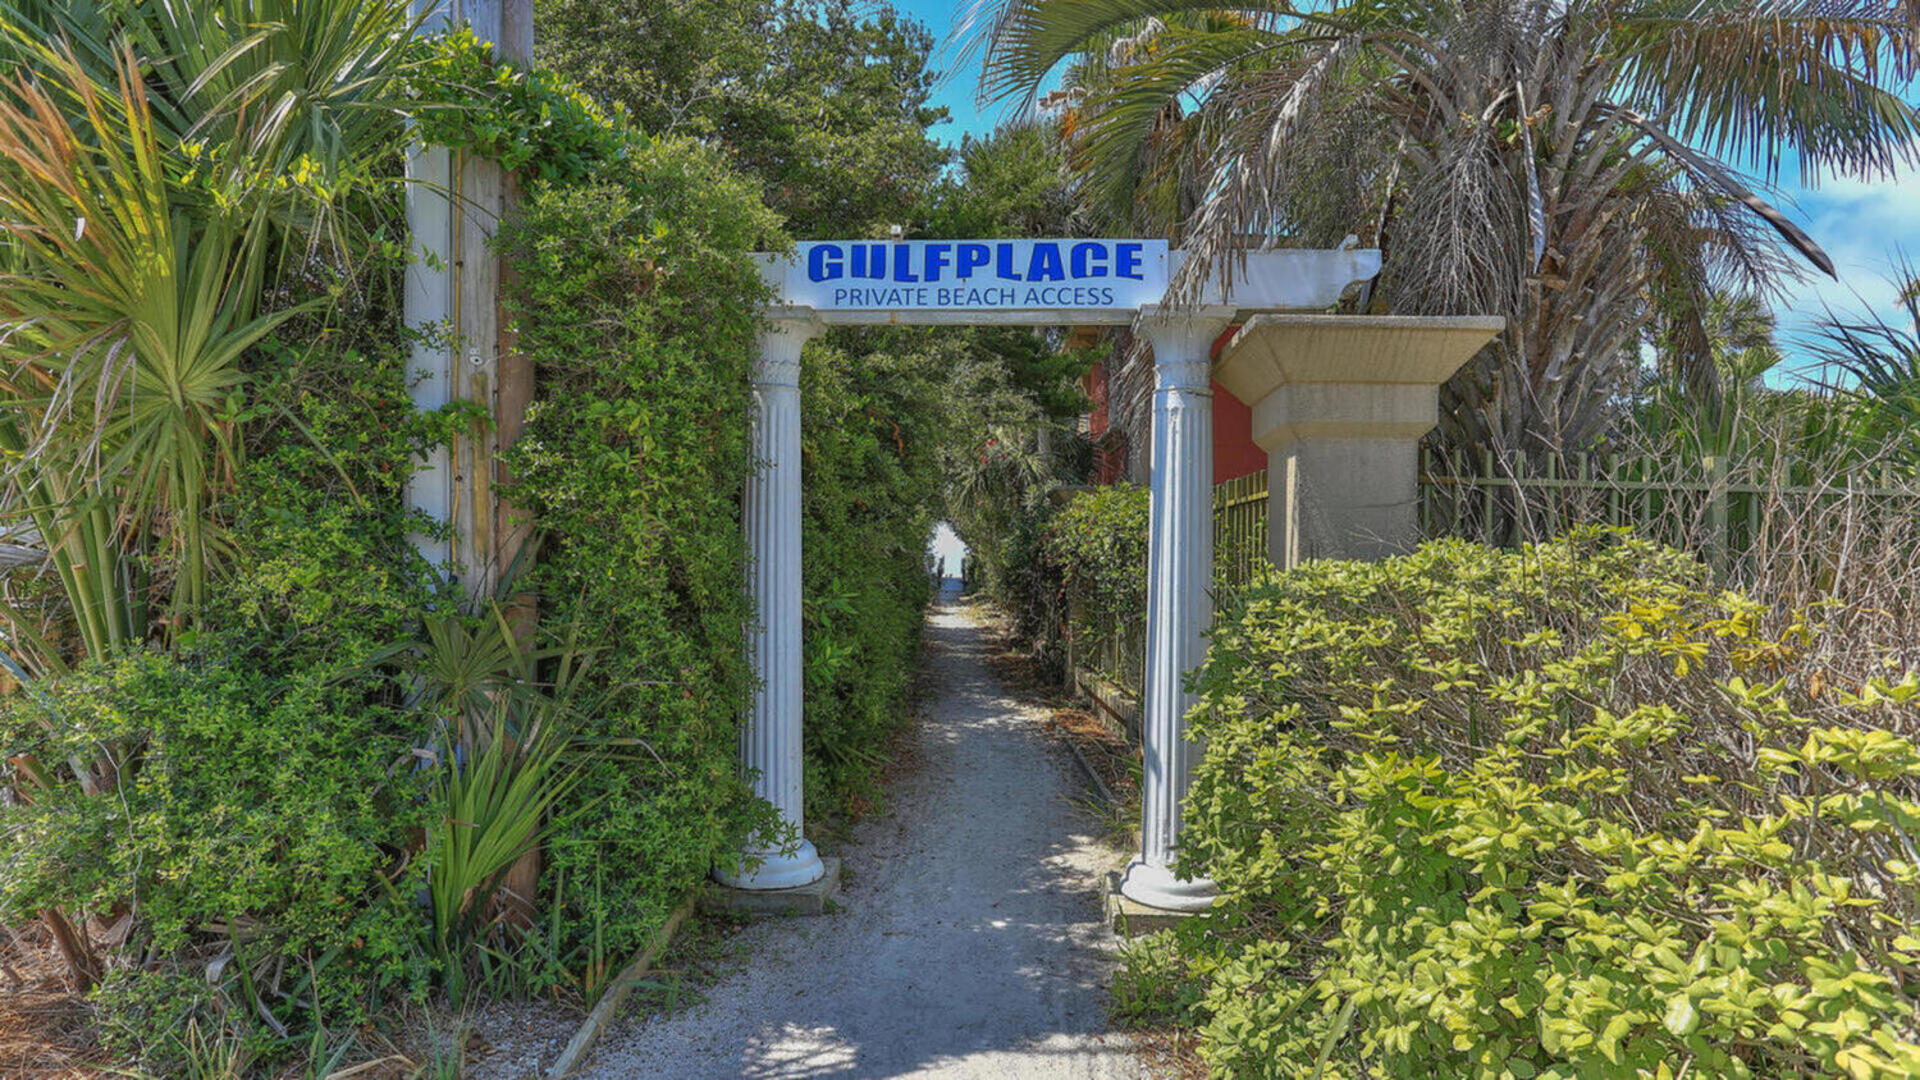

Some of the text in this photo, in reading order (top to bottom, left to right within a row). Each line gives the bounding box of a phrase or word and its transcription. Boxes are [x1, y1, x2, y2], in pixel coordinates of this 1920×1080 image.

[808, 242, 1144, 283] GULFPLACE
[834, 286, 1114, 307] PRIVATE BEACH ACCESS
